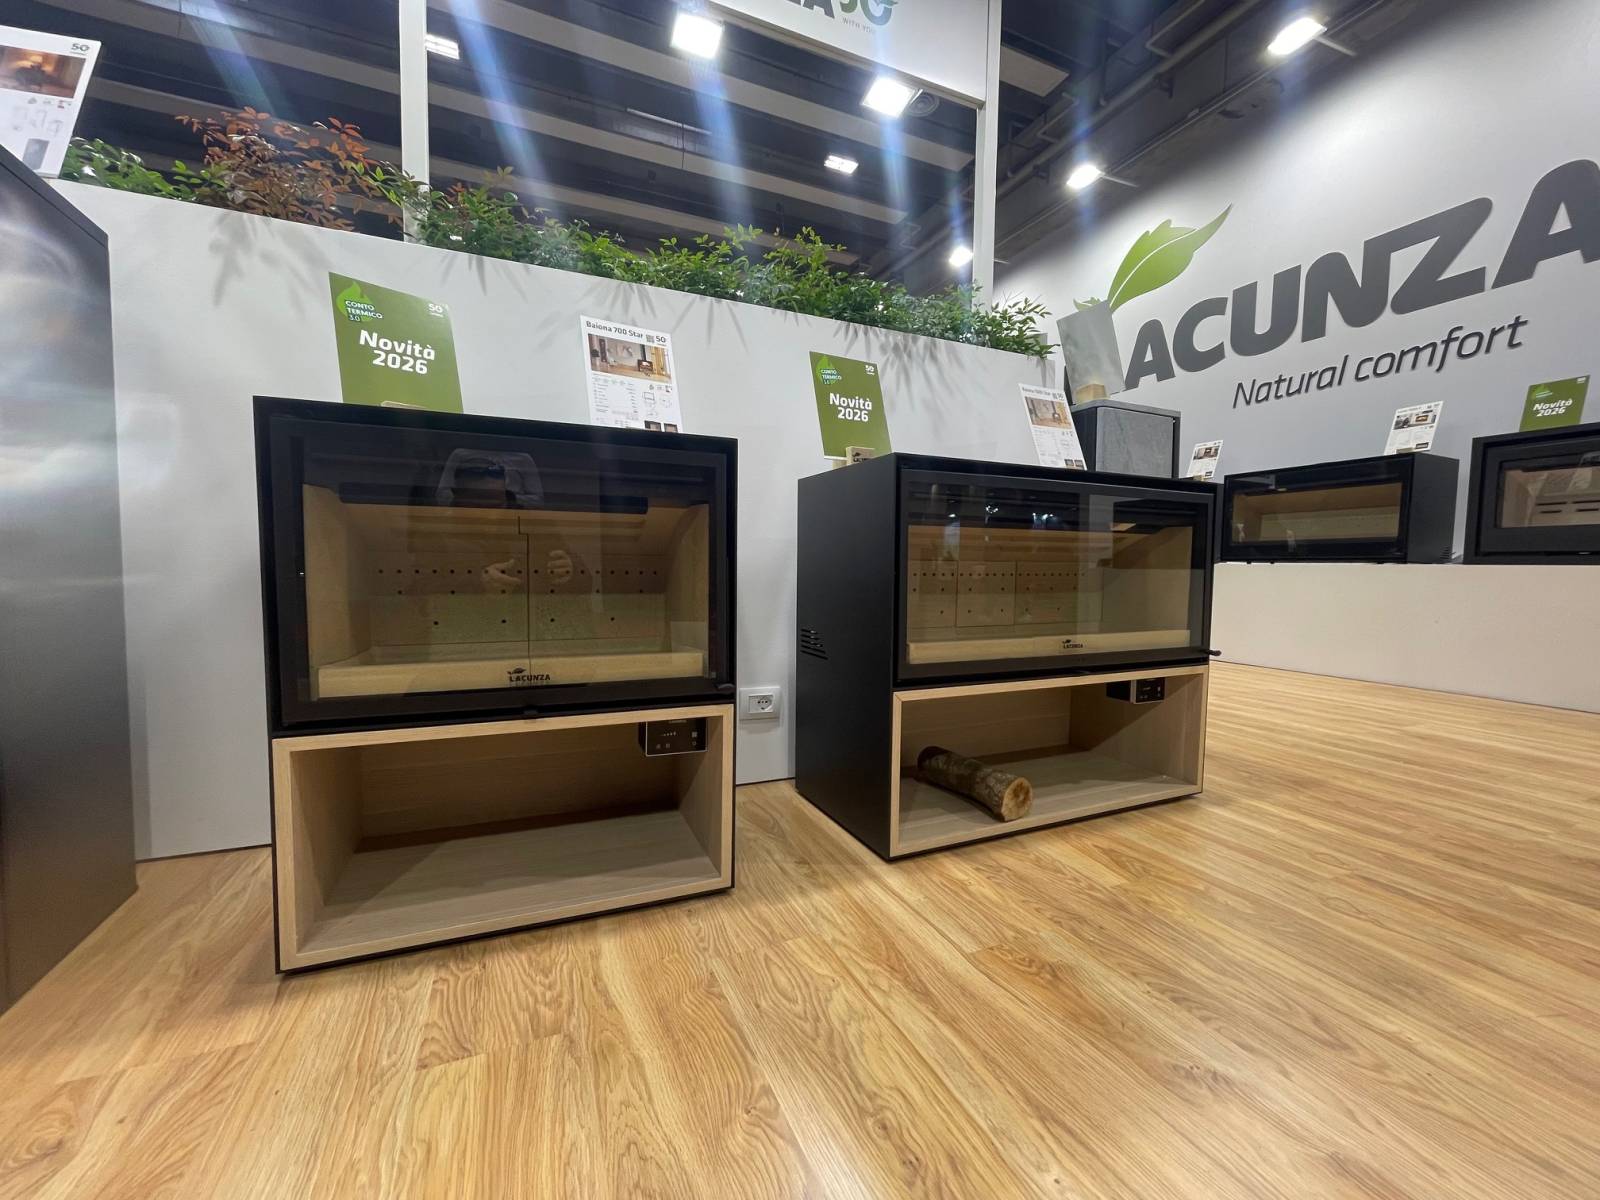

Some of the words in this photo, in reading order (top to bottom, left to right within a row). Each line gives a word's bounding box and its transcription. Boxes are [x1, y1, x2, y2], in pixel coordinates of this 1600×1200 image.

[1062, 158, 1600, 405] ACUNZA
[345, 300, 375, 311] CONTO
[346, 307, 383, 319] TERMICO
[585, 321, 612, 332] Baiona
[613, 326, 628, 336] 700
[628, 329, 643, 339] Star
[359, 329, 436, 361] Novità
[372, 349, 428, 375] 2026
[1232, 354, 1349, 409] Natural
[1354, 314, 1529, 383] comfort
[829, 392, 873, 410] Novità
[1532, 398, 1573, 411] Novità
[837, 407, 869, 422] 2026
[509, 674, 551, 682] LACUNZA
